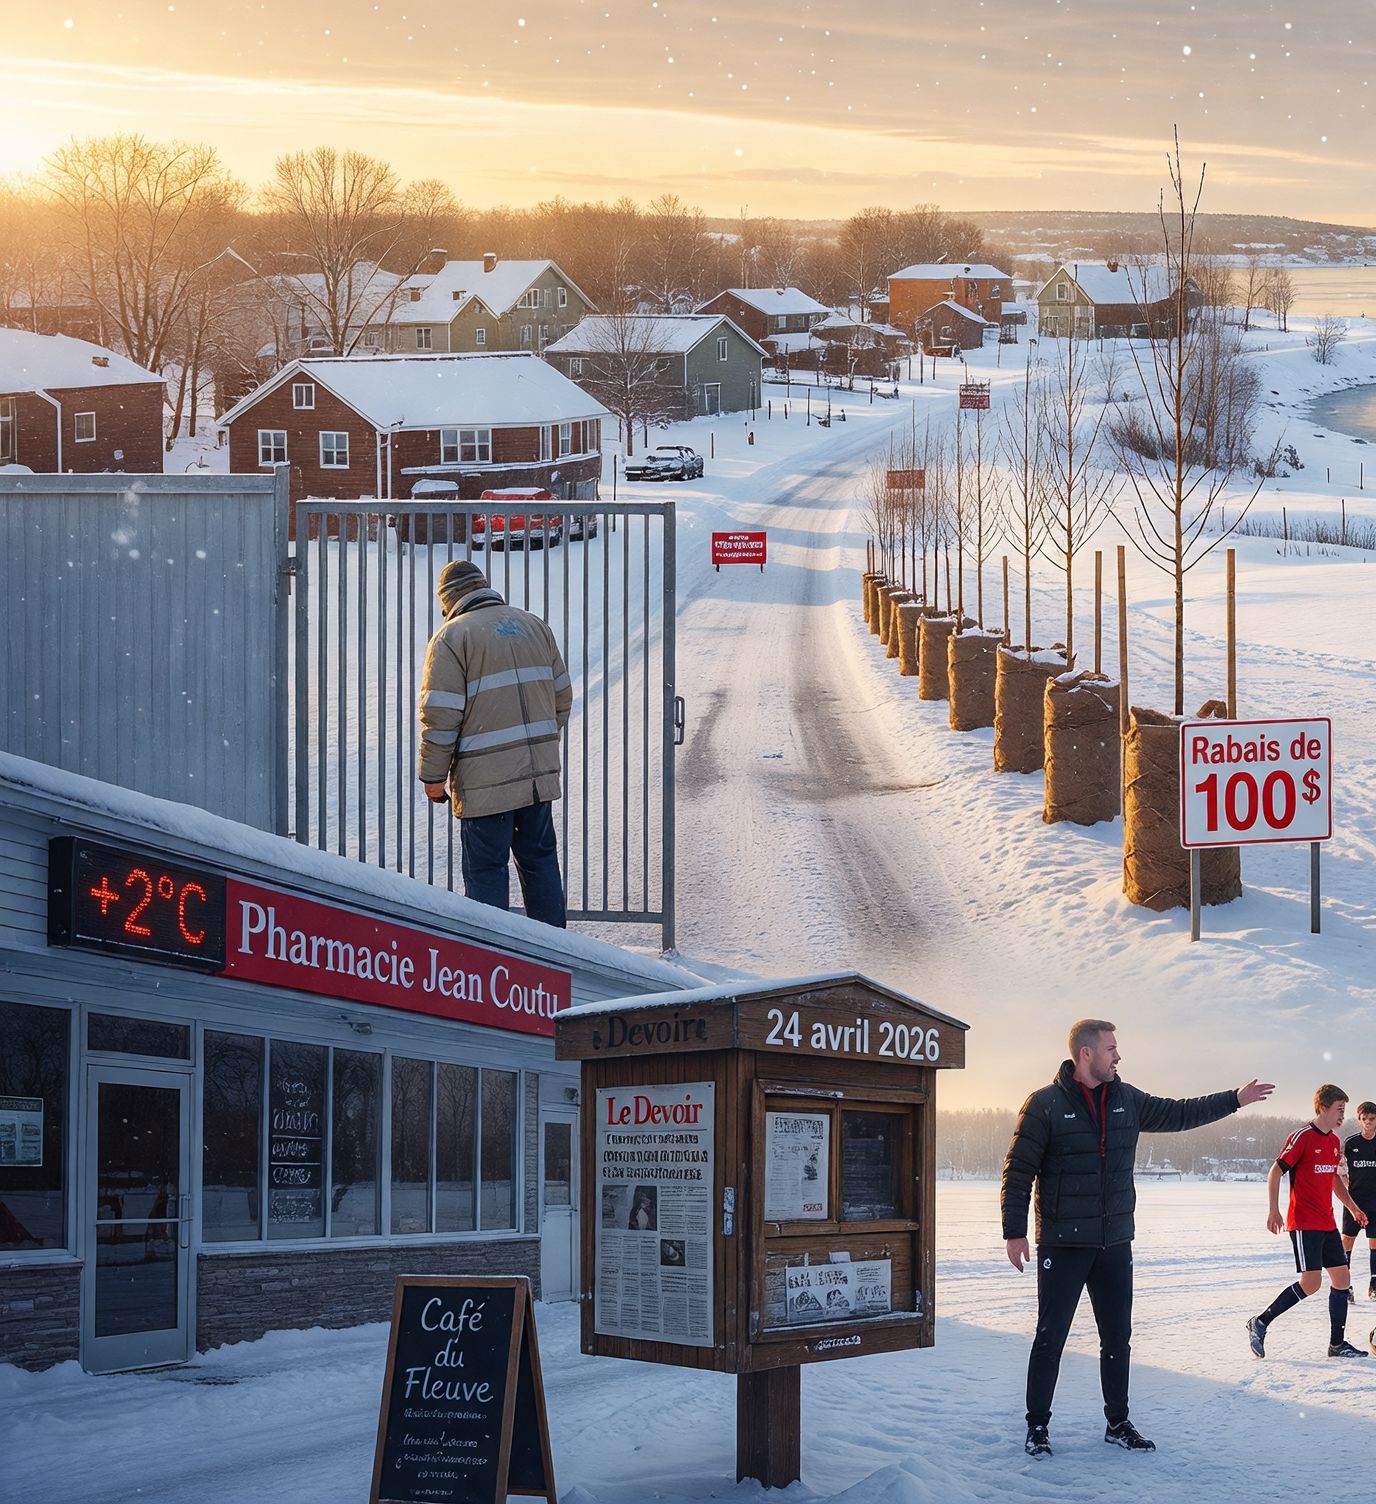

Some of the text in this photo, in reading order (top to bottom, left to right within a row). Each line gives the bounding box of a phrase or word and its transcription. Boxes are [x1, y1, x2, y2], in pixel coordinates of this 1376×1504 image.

[1192, 732, 1322, 764] Rabais de
[90, 867, 207, 944] +2°C
[236, 899, 558, 1019] Pharmacie Jean Coutu
[765, 1008, 940, 1062] 24 avril 2026
[606, 1094, 703, 1125] Le Devoir
[421, 1297, 485, 1343] Café
[434, 1339, 465, 1367] du
[404, 1367, 494, 1403] Fleuve
